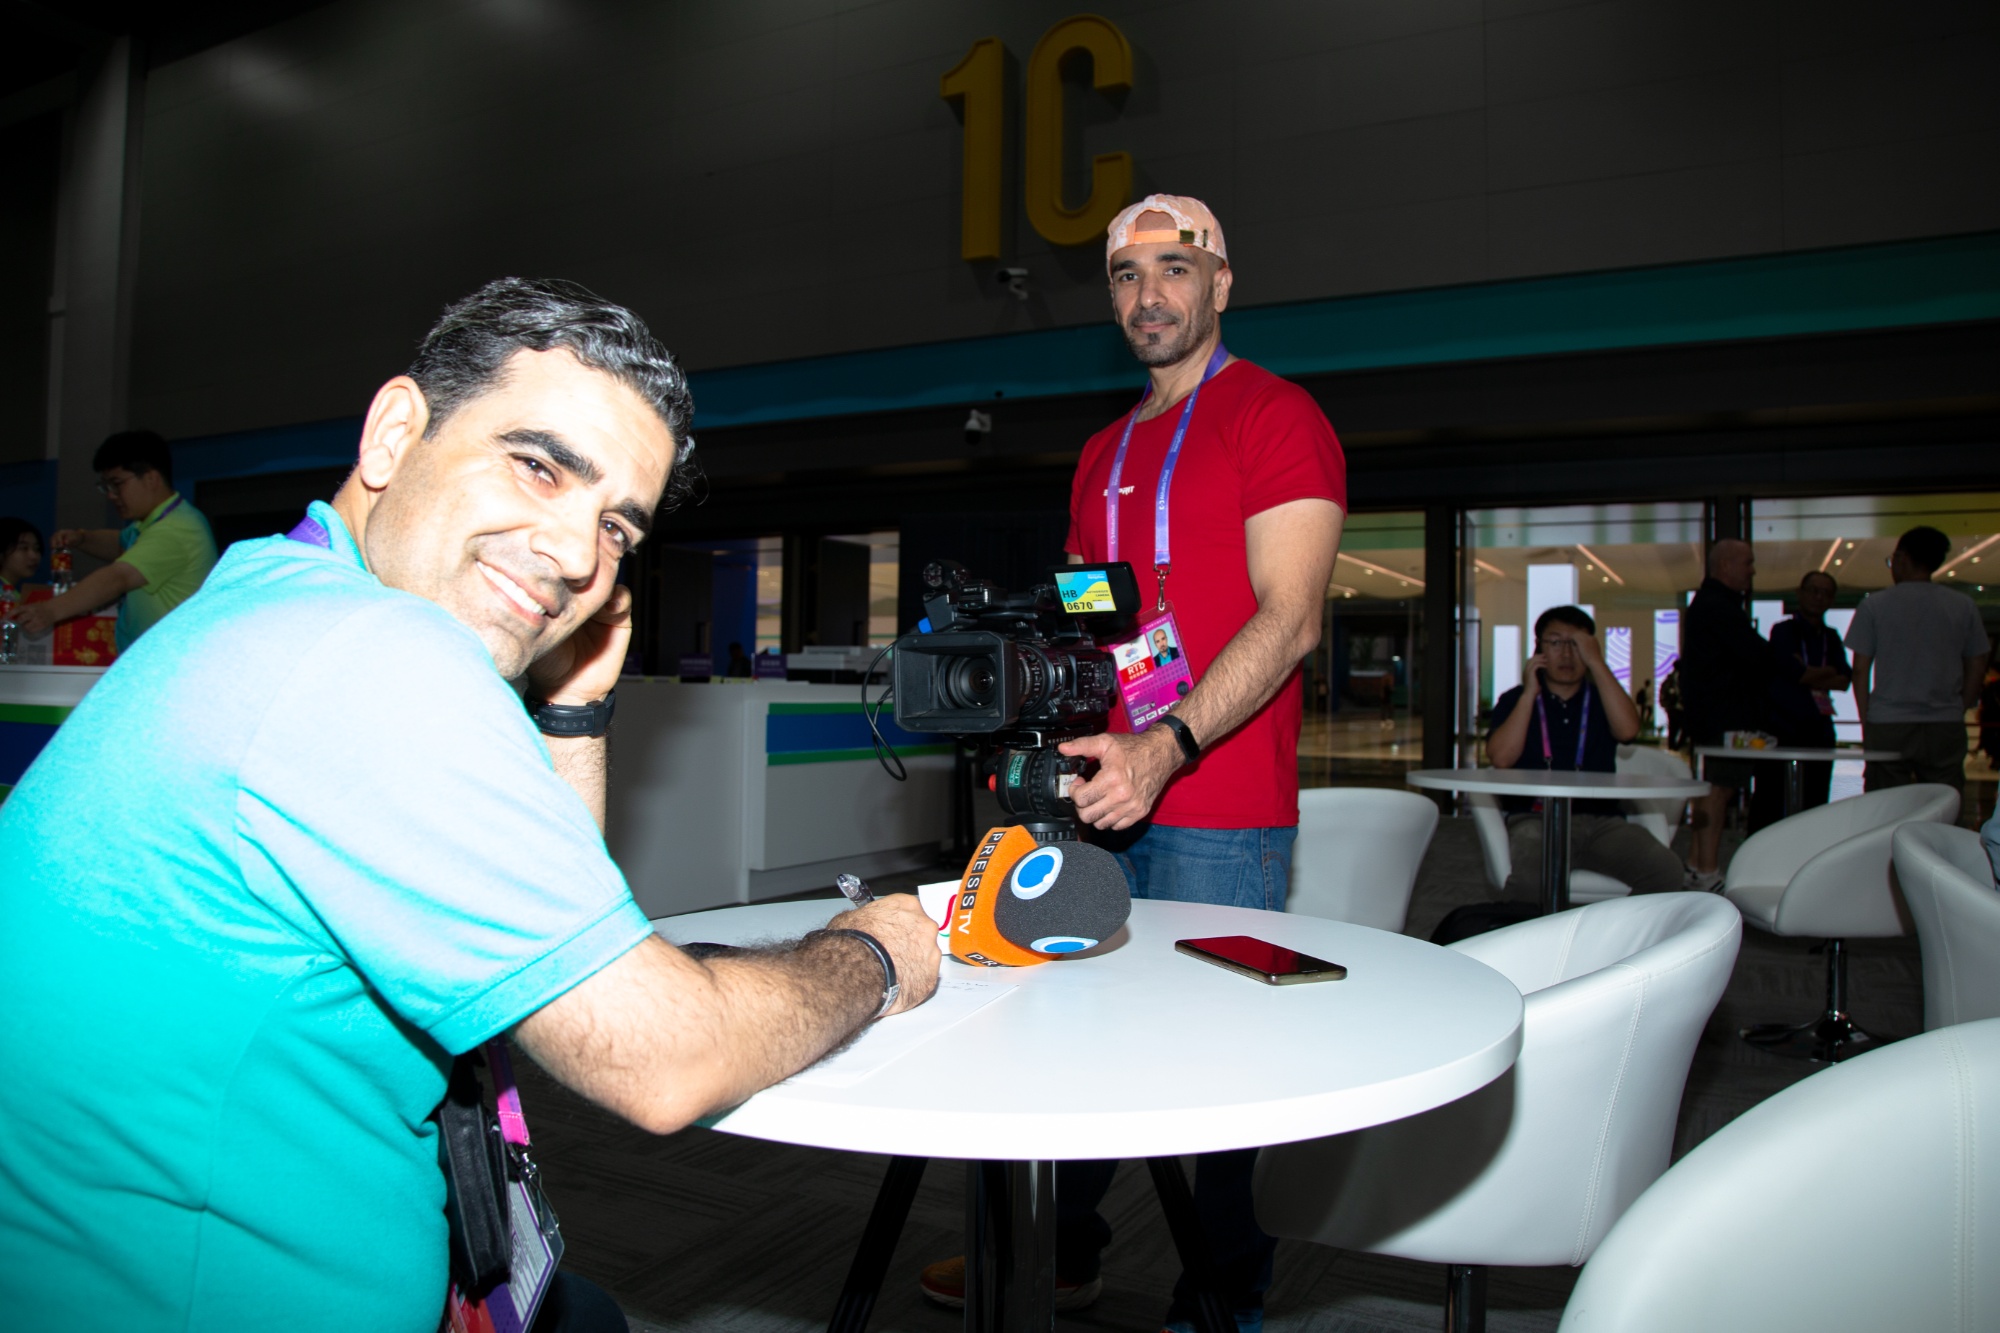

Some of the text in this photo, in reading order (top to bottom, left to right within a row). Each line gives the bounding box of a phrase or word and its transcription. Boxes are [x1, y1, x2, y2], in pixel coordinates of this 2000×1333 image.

[940, 13, 1133, 262] 1C
[1062, 590, 1078, 598] HB
[1066, 602, 1093, 610] 0670
[1127, 661, 1146, 675] RTb
[958, 832, 1004, 935] PRESS TV
